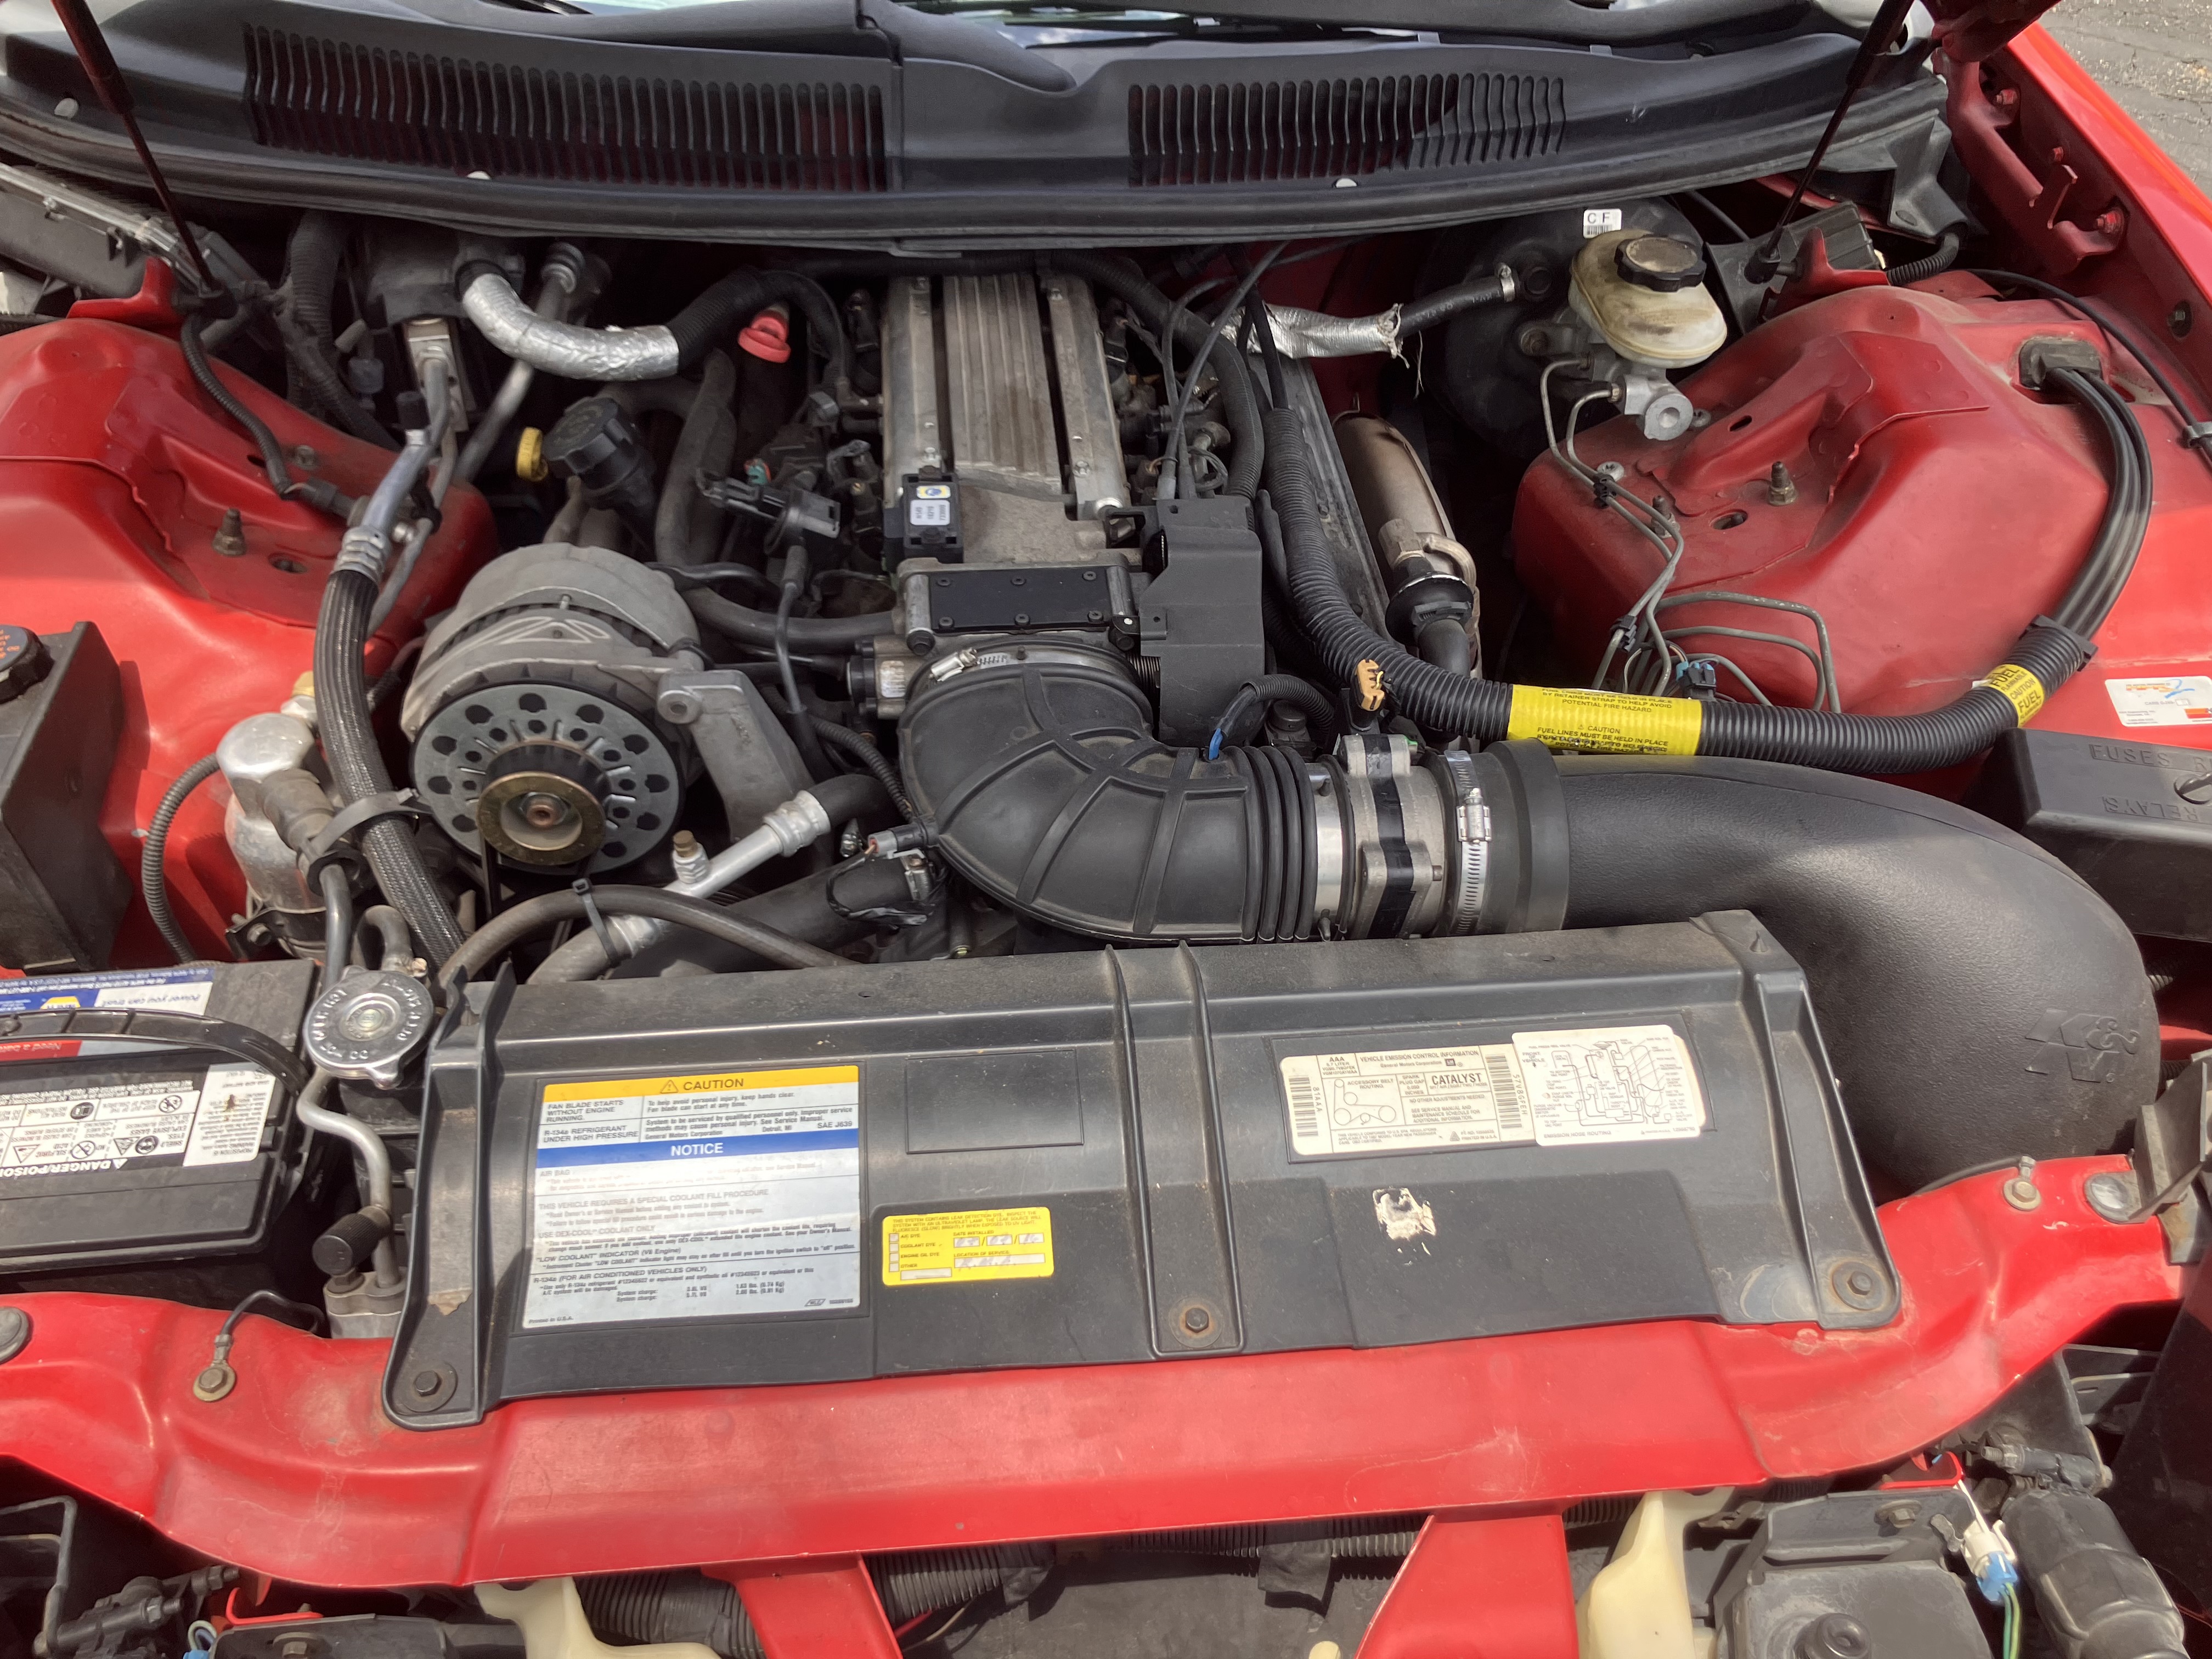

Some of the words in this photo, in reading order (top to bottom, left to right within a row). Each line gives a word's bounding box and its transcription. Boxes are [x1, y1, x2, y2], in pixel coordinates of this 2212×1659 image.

[1588, 212, 1596, 223] C
[1602, 212, 1610, 223] F
[1990, 669, 2020, 687] FUEL
[2010, 678, 2036, 700] CAUTION
[2018, 690, 2040, 713] FUEL
[2089, 744, 2169, 766] FUSES
[2104, 797, 2199, 822] RELAYS
[146, 995, 167, 1003] you
[1440, 1049, 1479, 1058] INFORMATION
[684, 1077, 744, 1091] CAUTION
[1431, 1072, 1483, 1085] CATALYST
[1313, 1086, 1323, 1112] 81AAA
[1513, 1074, 1528, 1115] 57V8GFEH
[571, 1125, 627, 1134] REFRIGERANT
[596, 1131, 639, 1139] PRESSURE
[670, 1142, 724, 1156] NOTICE
[590, 1198, 628, 1206] REQUIRES
[724, 1189, 769, 1198] PROCEDURE
[599, 1226, 634, 1234] COOLANT
[599, 1250, 639, 1258] INDICATOR
[593, 1270, 645, 1279] CONDITIONED
